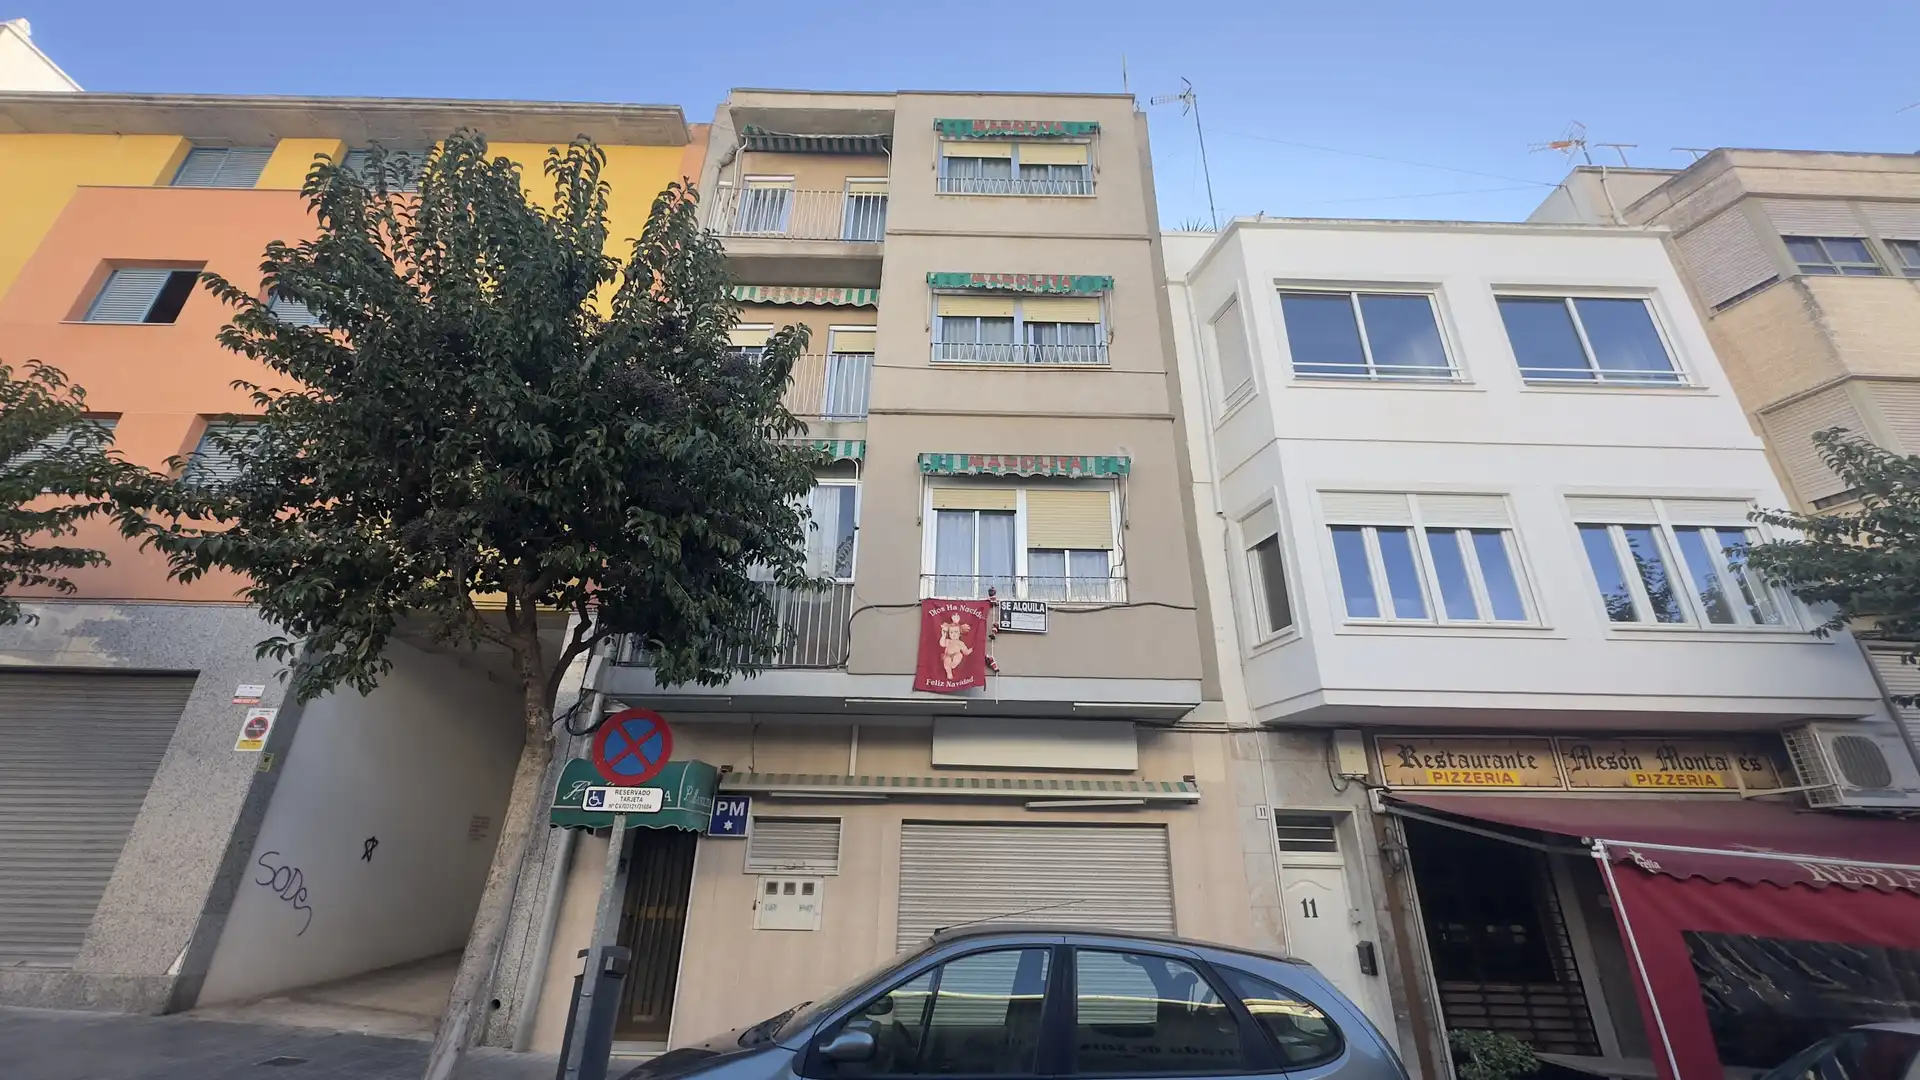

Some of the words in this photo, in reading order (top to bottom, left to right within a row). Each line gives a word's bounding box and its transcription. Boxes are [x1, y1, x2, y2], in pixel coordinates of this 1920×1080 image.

[928, 606, 946, 617] Dios
[946, 603, 958, 611] Ha
[1001, 601, 1012, 611] SE
[1012, 602, 1046, 613] ALQUILA
[926, 678, 945, 687] Feliz
[946, 675, 974, 688] Navidad
[1394, 744, 1539, 769] Restaurante
[1432, 772, 1514, 784] PIZZERIA
[1635, 774, 1718, 786] PIZZERIA
[716, 801, 745, 816] PM
[1260, 807, 1267, 817] 11
[1301, 898, 1318, 918] 11
